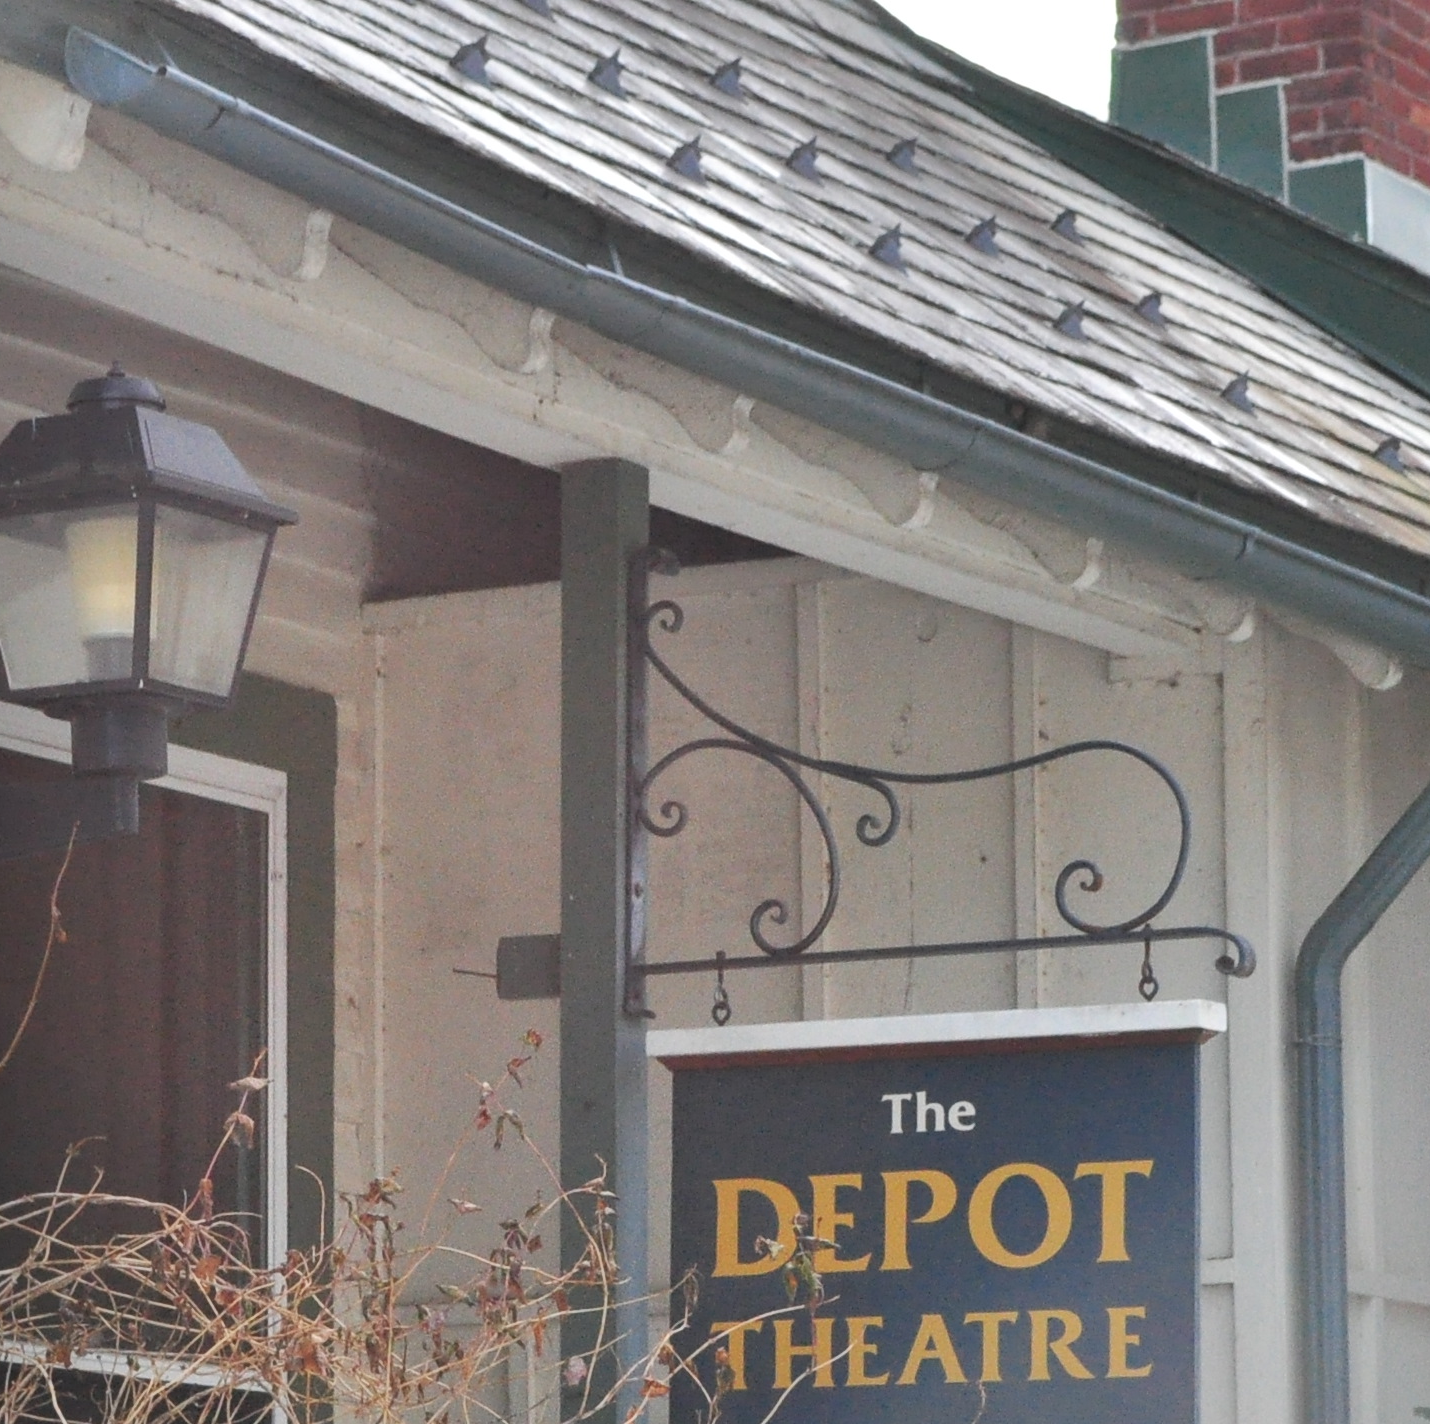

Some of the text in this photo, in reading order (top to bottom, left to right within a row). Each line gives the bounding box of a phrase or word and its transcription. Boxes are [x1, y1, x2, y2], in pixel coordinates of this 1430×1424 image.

[881, 1091, 976, 1134] The
[711, 1160, 1154, 1278] DEPOT
[710, 1306, 1153, 1390] THEATRE
